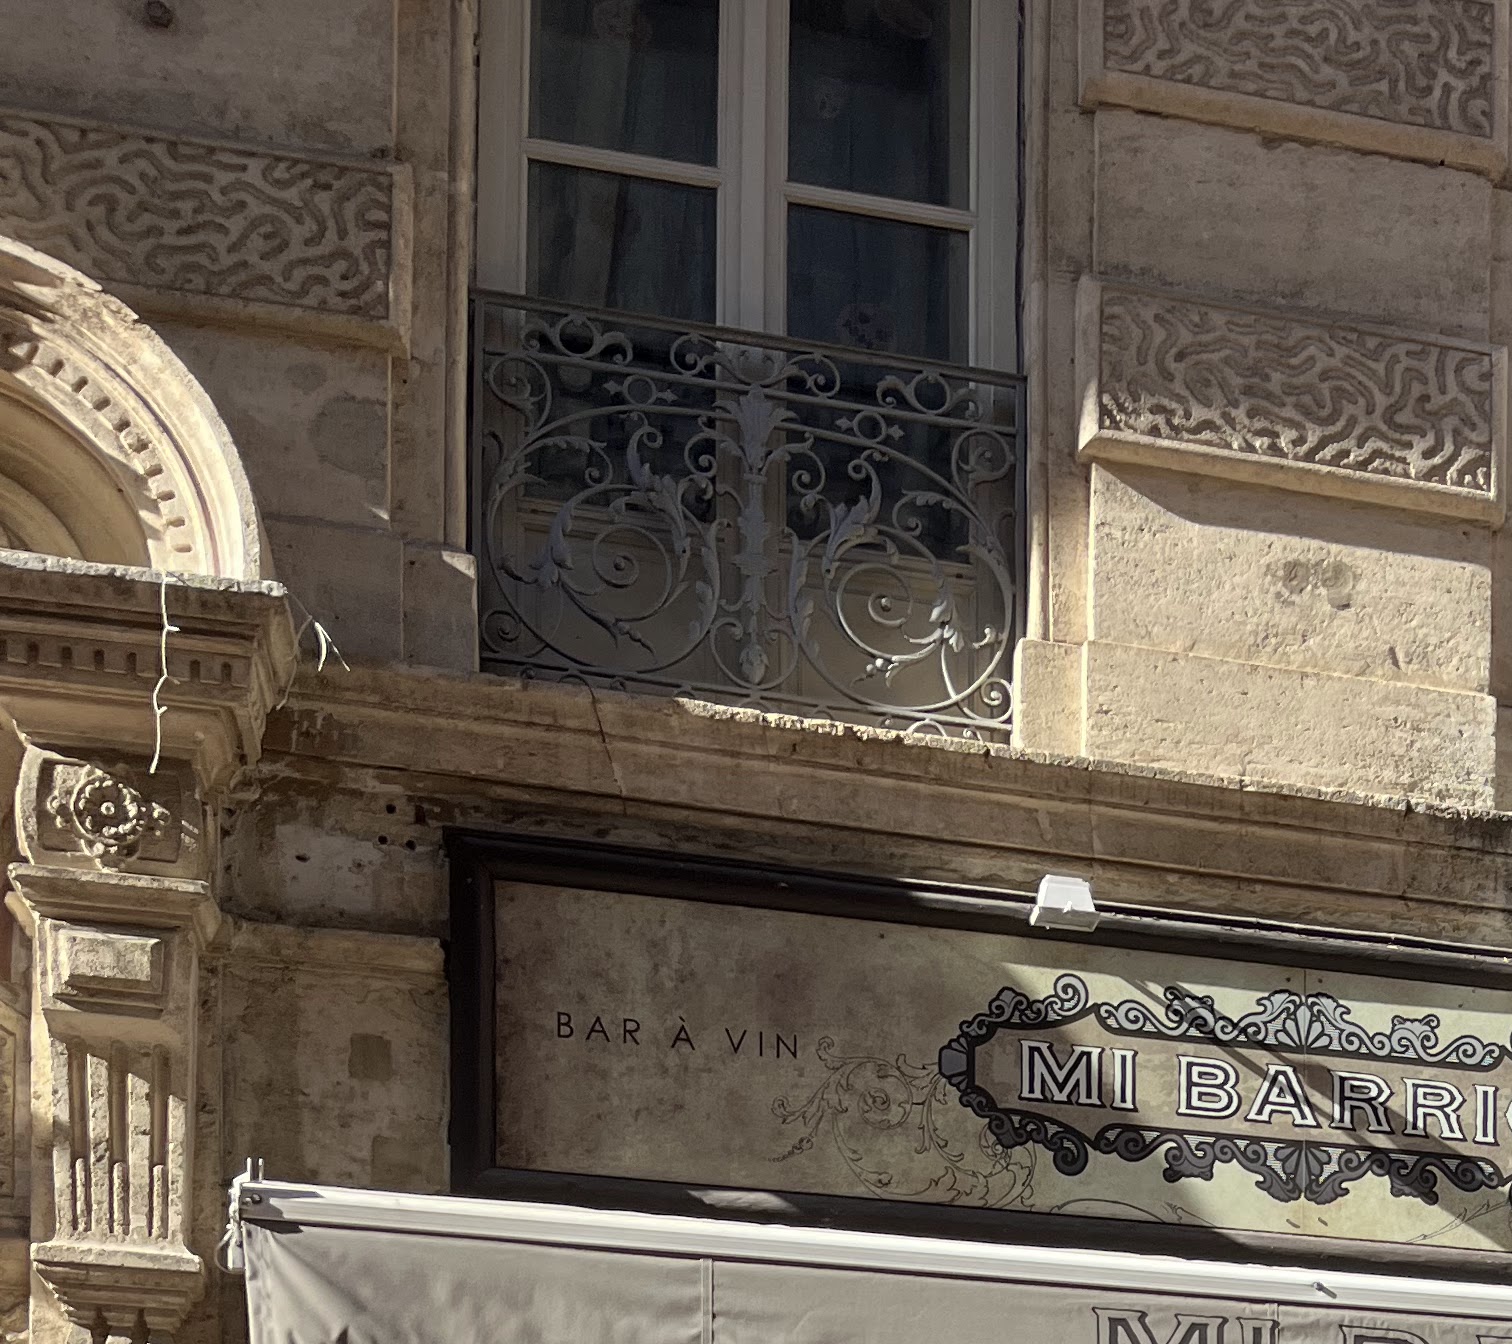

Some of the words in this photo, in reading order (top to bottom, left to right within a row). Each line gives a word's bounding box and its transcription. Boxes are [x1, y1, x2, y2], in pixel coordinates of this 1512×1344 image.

[555, 1011, 642, 1046] BAR
[670, 1016, 697, 1051] À
[725, 1027, 801, 1060] VIN
[1017, 1039, 1139, 1112] MI
